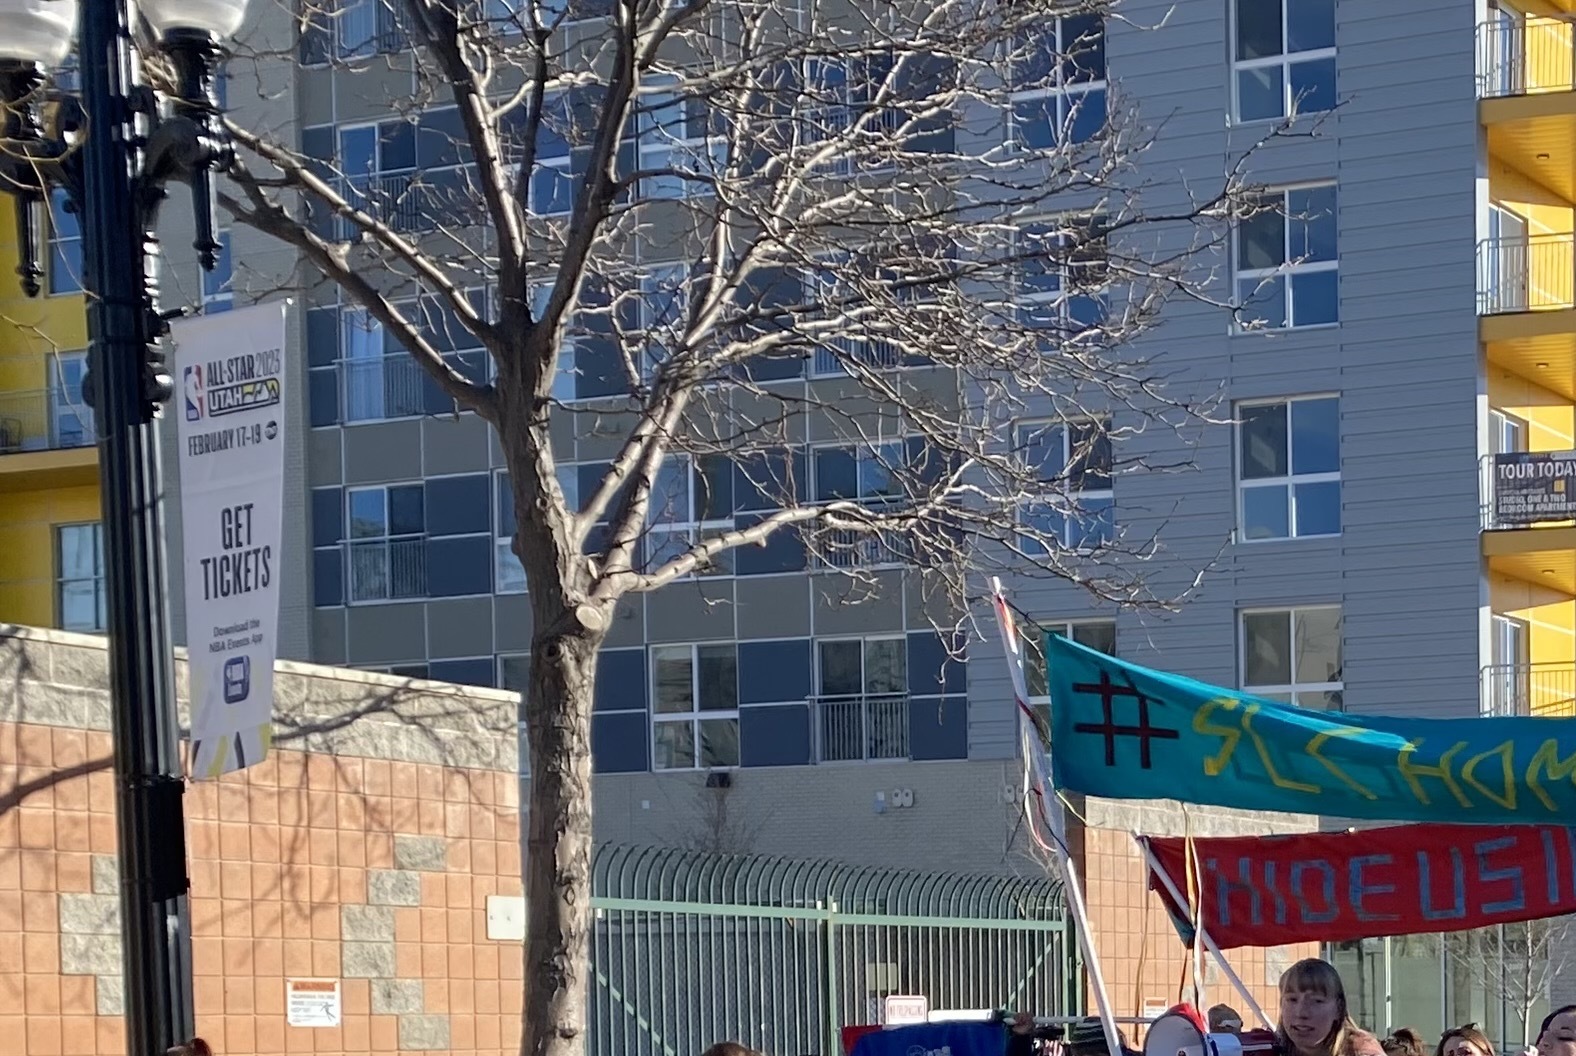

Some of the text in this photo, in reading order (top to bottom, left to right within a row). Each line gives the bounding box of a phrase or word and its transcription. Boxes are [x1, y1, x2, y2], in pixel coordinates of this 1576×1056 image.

[209, 386, 243, 411] UTAH
[188, 429, 235, 457] FEBRUARY
[236, 424, 262, 448] 17-19
[1498, 462, 1535, 479] TOUR
[221, 503, 254, 550] GET
[200, 545, 270, 600] TICKETS
[213, 621, 249, 638] Download
[209, 641, 226, 653] NBA
[1206, 853, 1399, 926] HIDE
[1416, 836, 1525, 920] US
